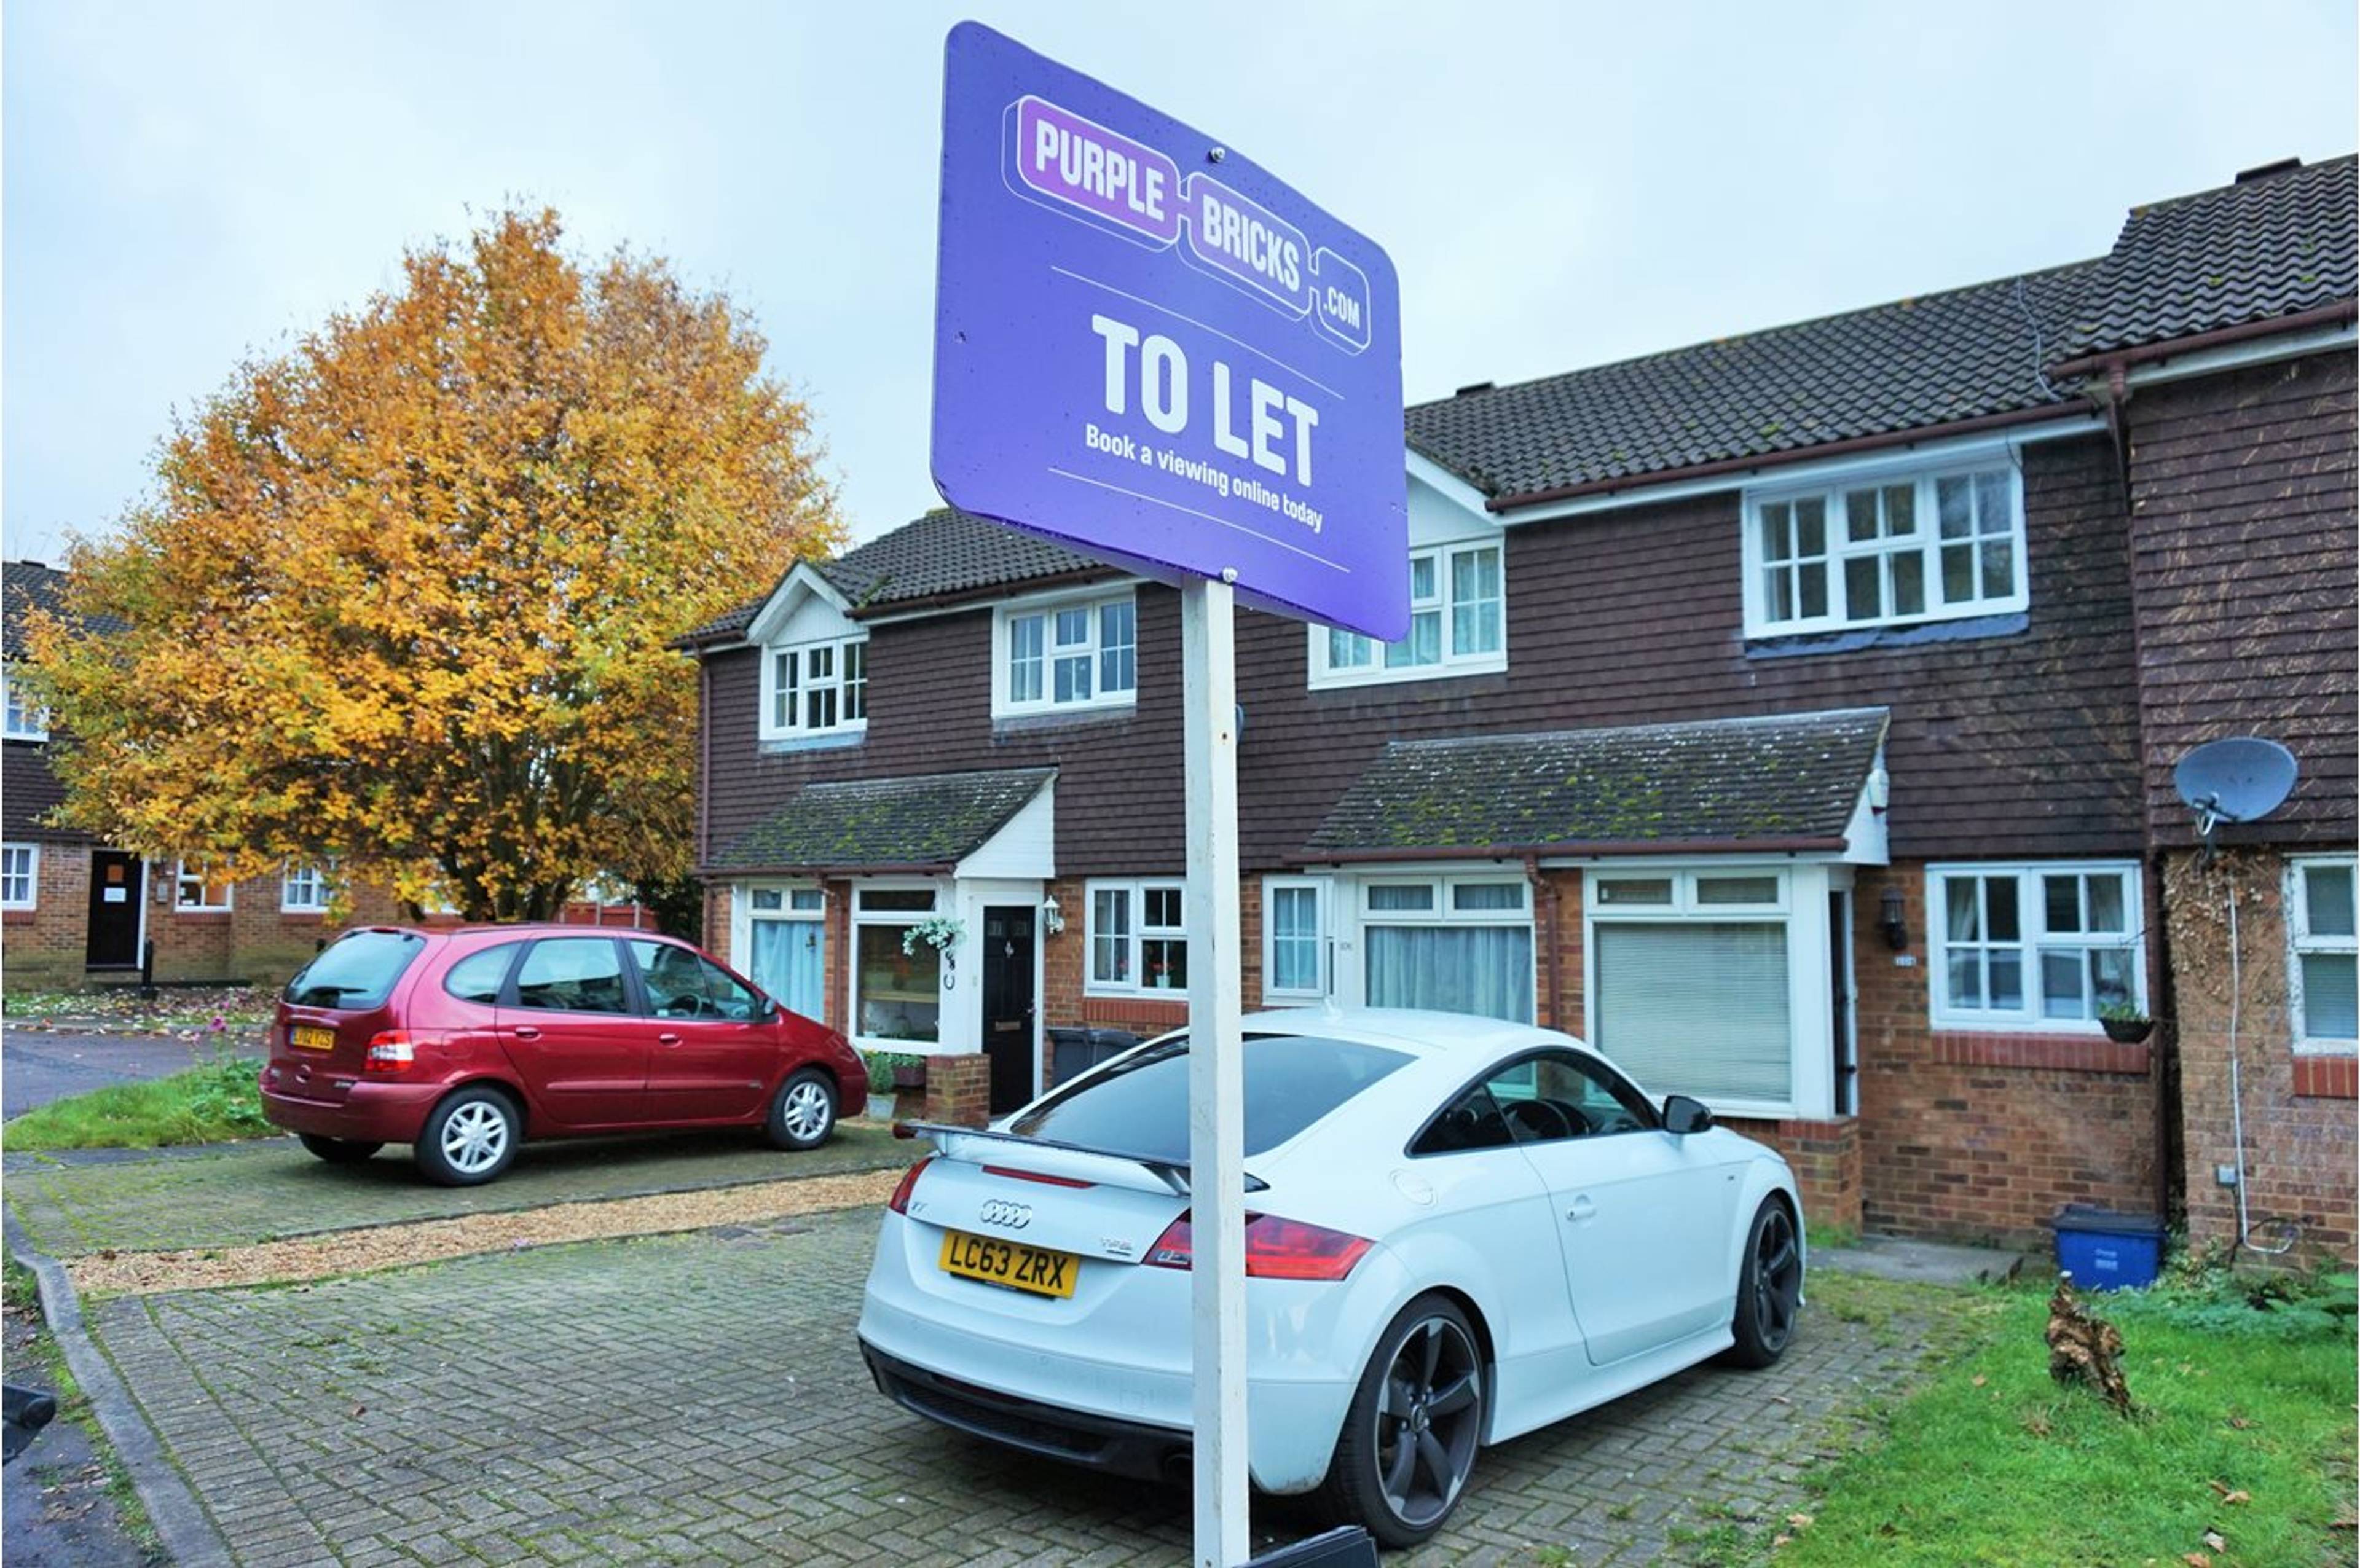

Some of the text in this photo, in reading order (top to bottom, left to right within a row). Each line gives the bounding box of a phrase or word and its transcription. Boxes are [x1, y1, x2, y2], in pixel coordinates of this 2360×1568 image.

[1036, 120, 1360, 330] PURPLE BRICKS .COM
[1092, 314, 1318, 487] TO LET
[1086, 423, 1323, 533] Book a viewing online today
[950, 1236, 1068, 1290] LC63 ZRX
